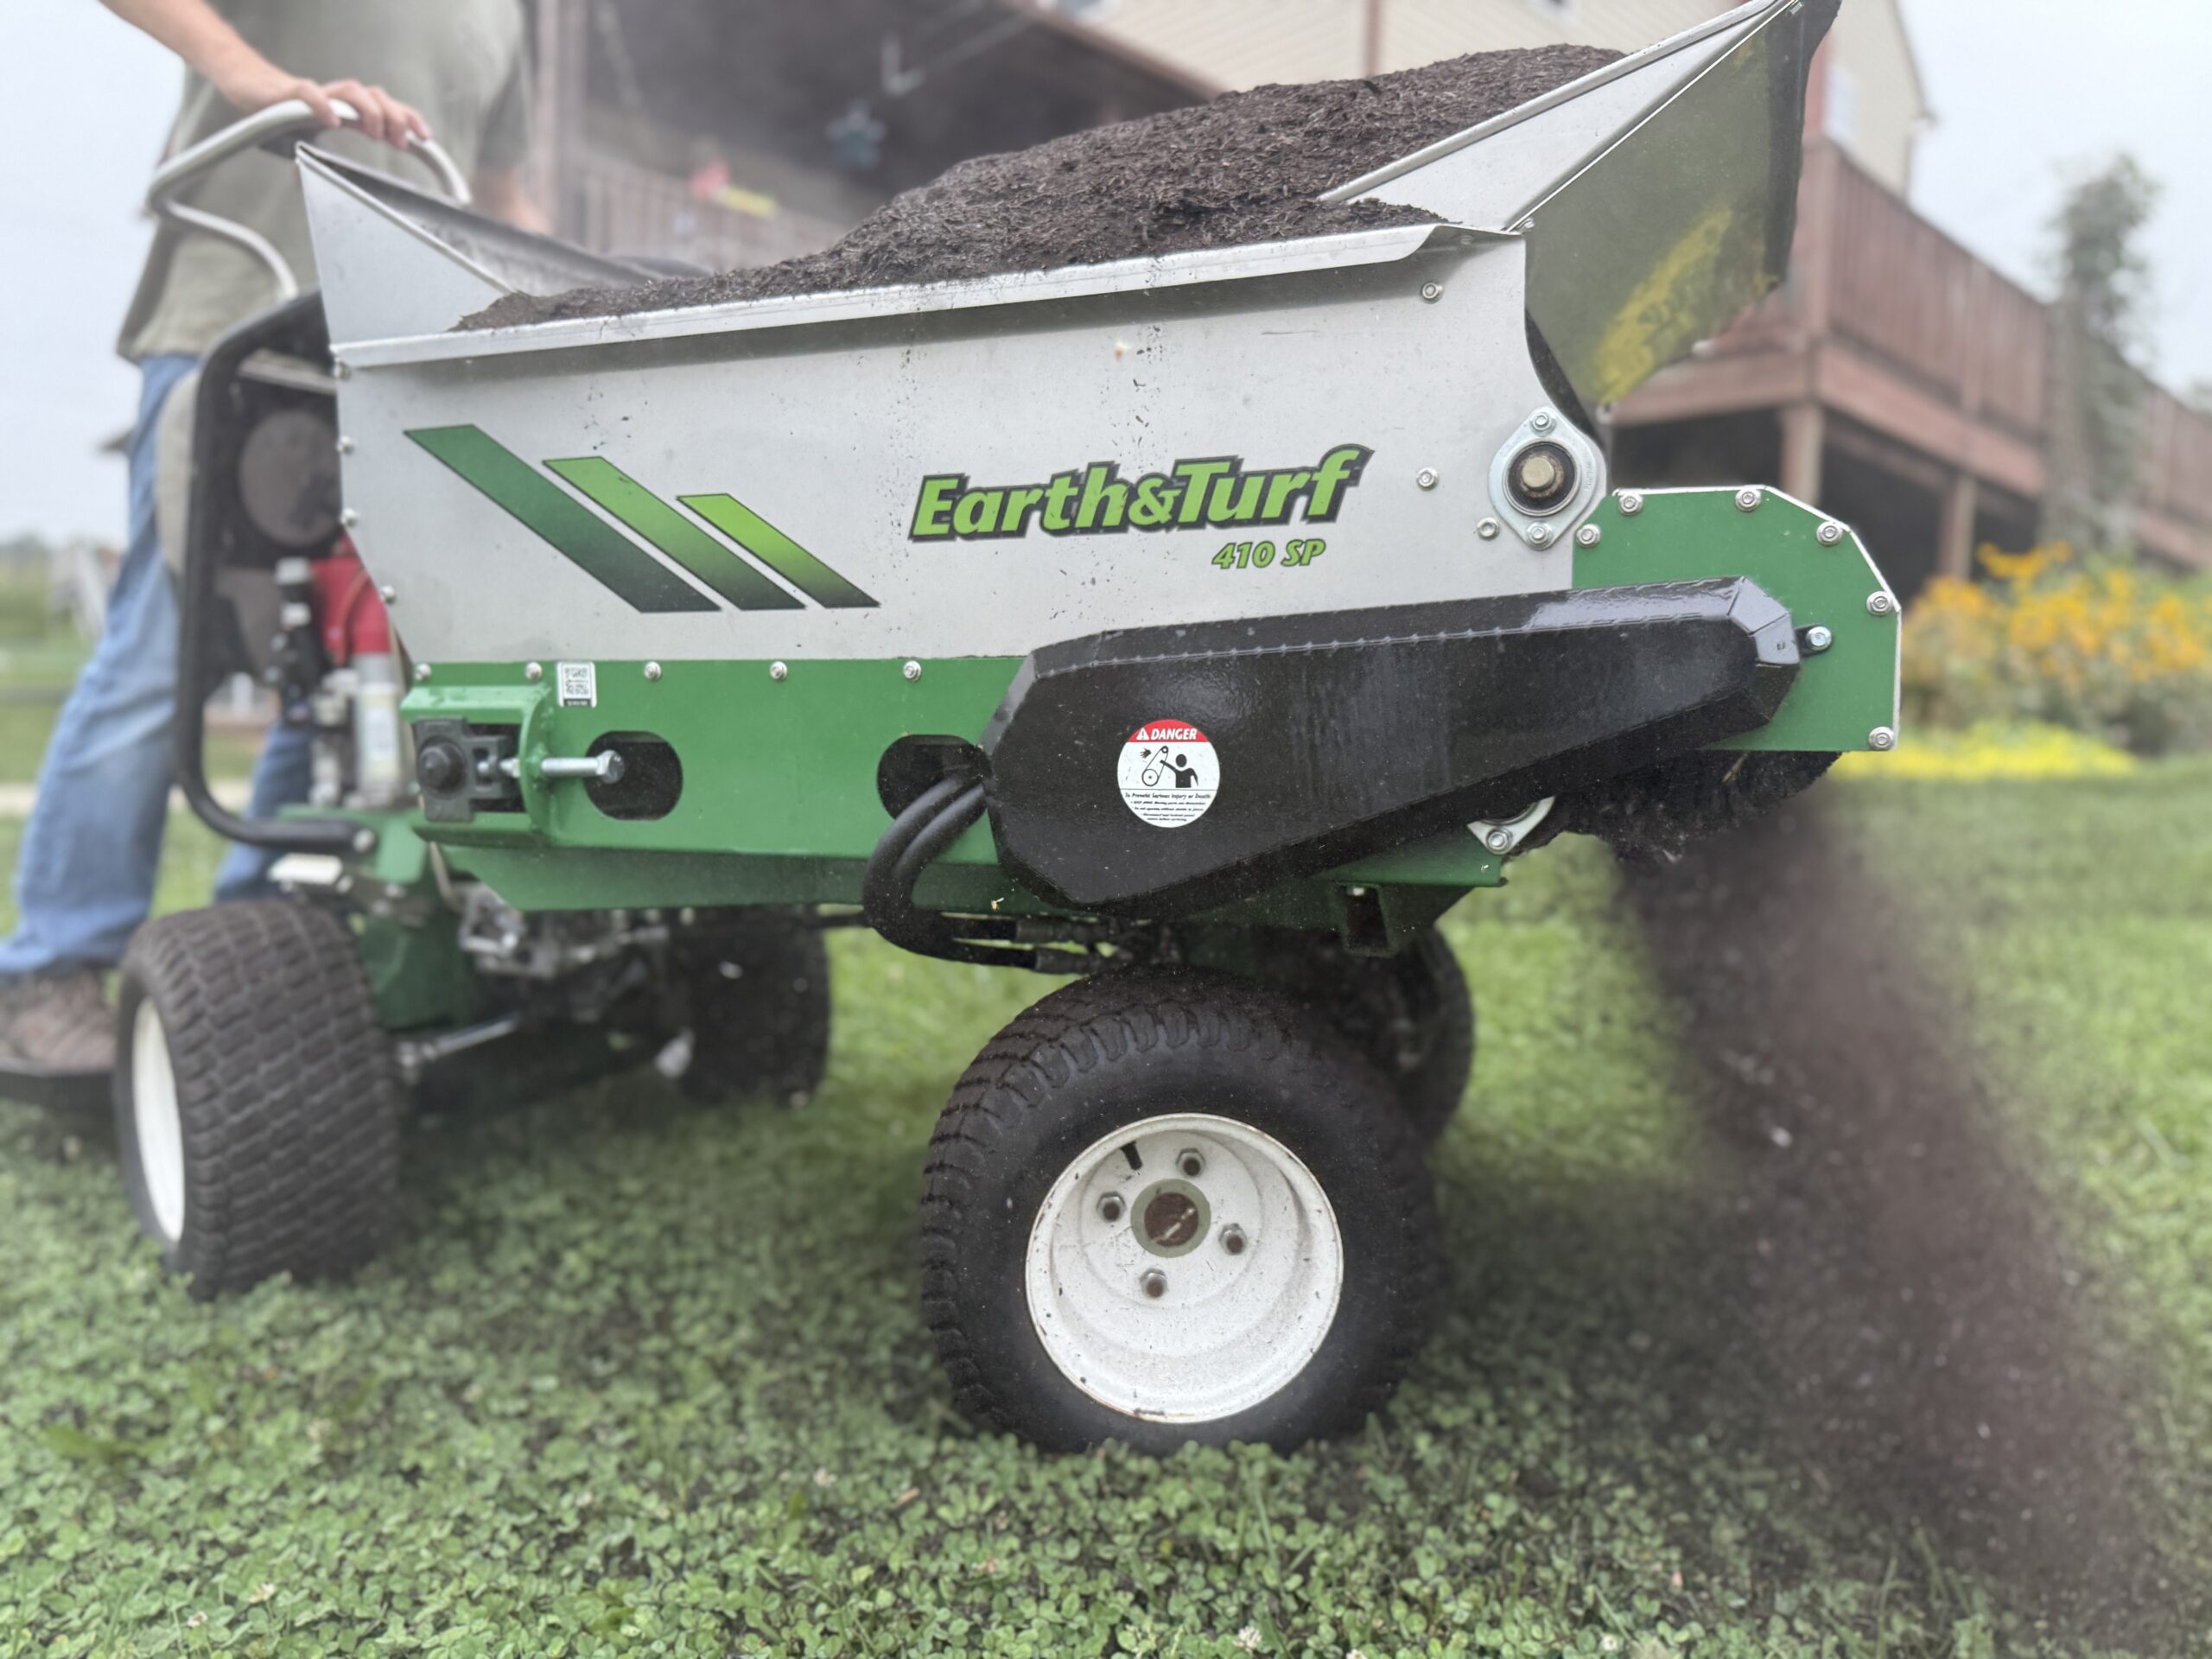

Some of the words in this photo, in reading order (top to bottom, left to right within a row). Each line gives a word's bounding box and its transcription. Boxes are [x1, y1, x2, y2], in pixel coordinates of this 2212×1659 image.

[909, 443, 1375, 542] Earth&Turf
[1211, 540, 1275, 569] 410
[1281, 538, 1326, 567] SP
[1151, 728, 1198, 741] DANGER
